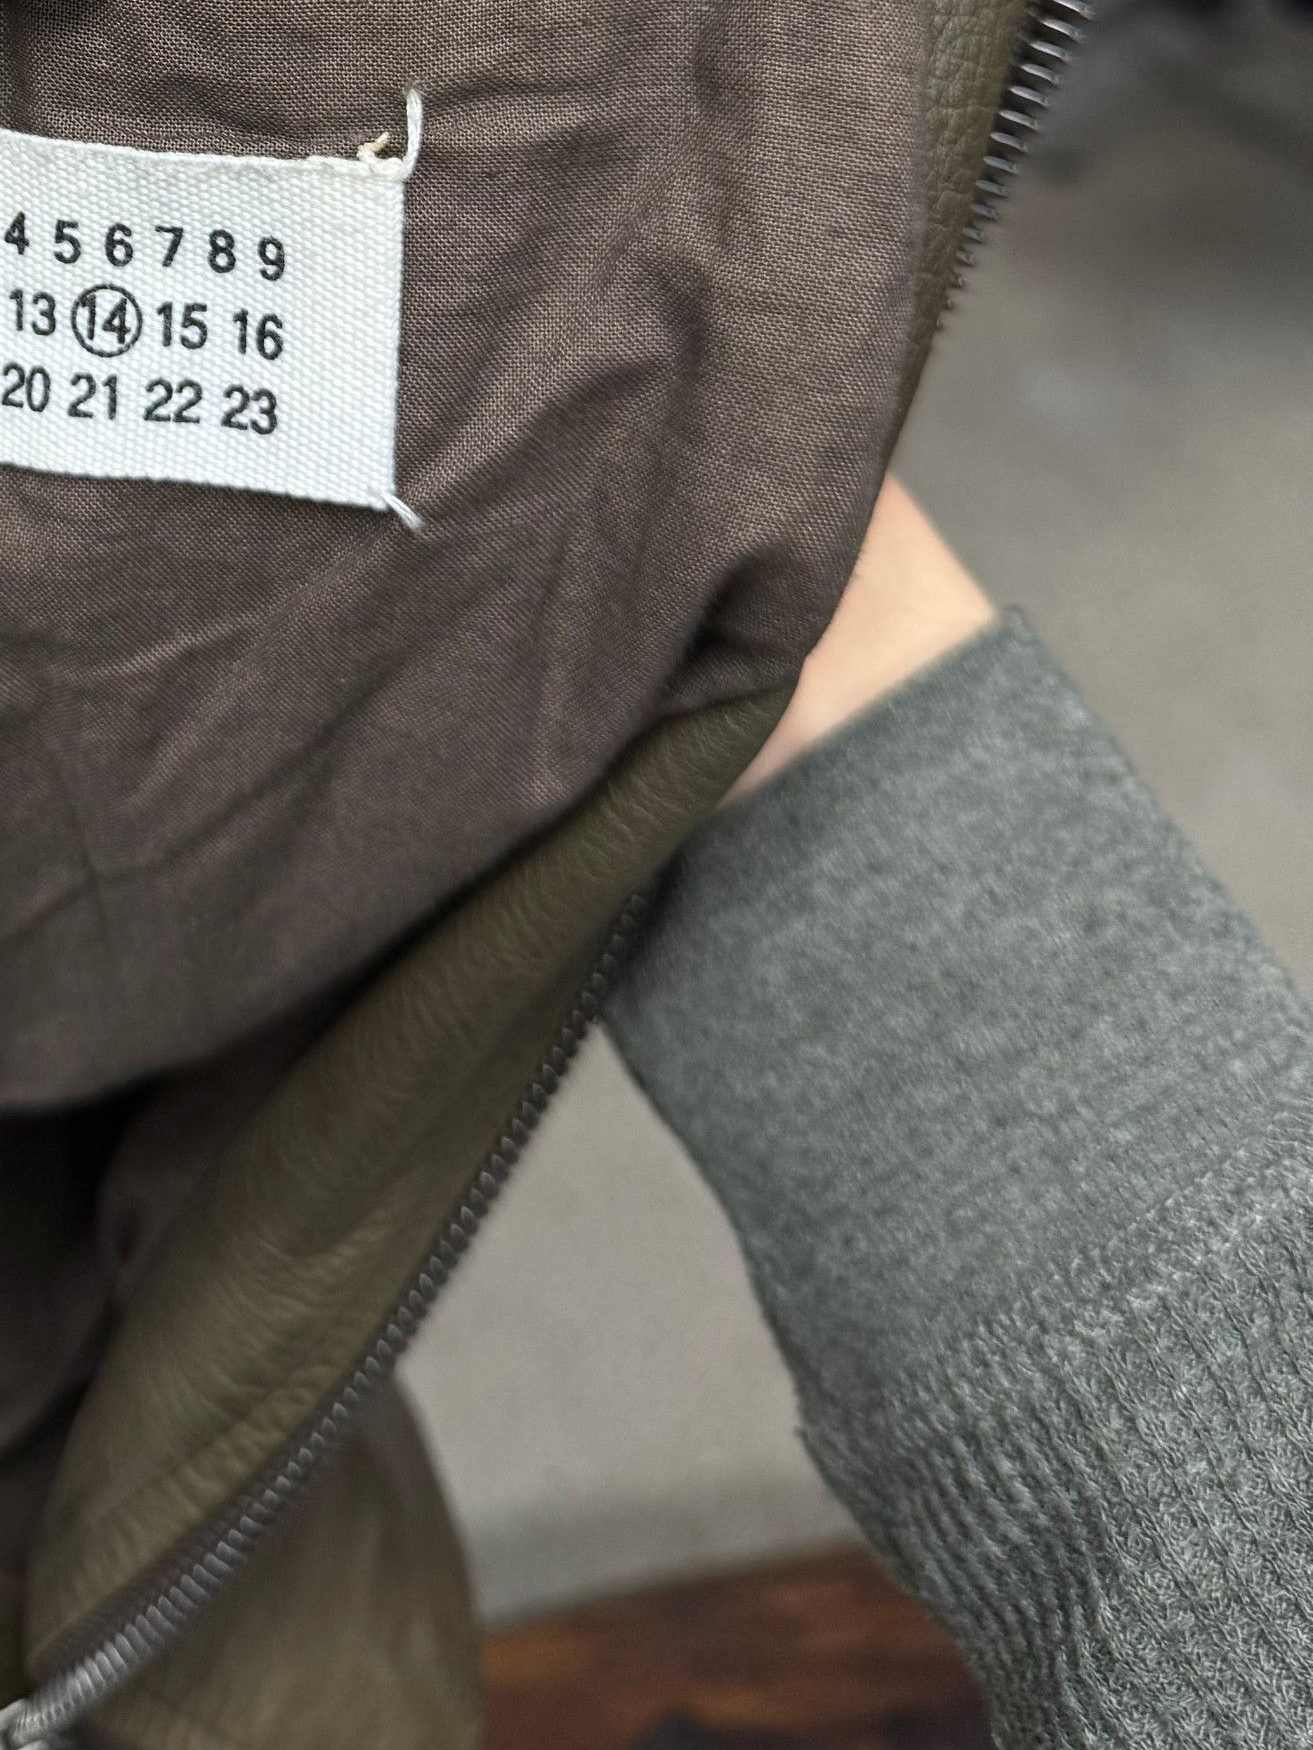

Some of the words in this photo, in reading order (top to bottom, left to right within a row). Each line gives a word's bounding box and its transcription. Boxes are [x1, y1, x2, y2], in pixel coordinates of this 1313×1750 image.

[4, 212, 30, 255] 4
[54, 220, 81, 263] 5
[105, 223, 134, 267] 6
[155, 226, 183, 267] 7
[209, 229, 236, 273] 8
[258, 236, 286, 281] 9
[9, 290, 57, 336] 13
[84, 299, 131, 344] 14
[158, 302, 208, 349] 15
[234, 310, 284, 360] 16
[2, 363, 50, 412] 20
[69, 375, 118, 421] 21
[144, 379, 201, 424] 22
[221, 386, 279, 435] 23
